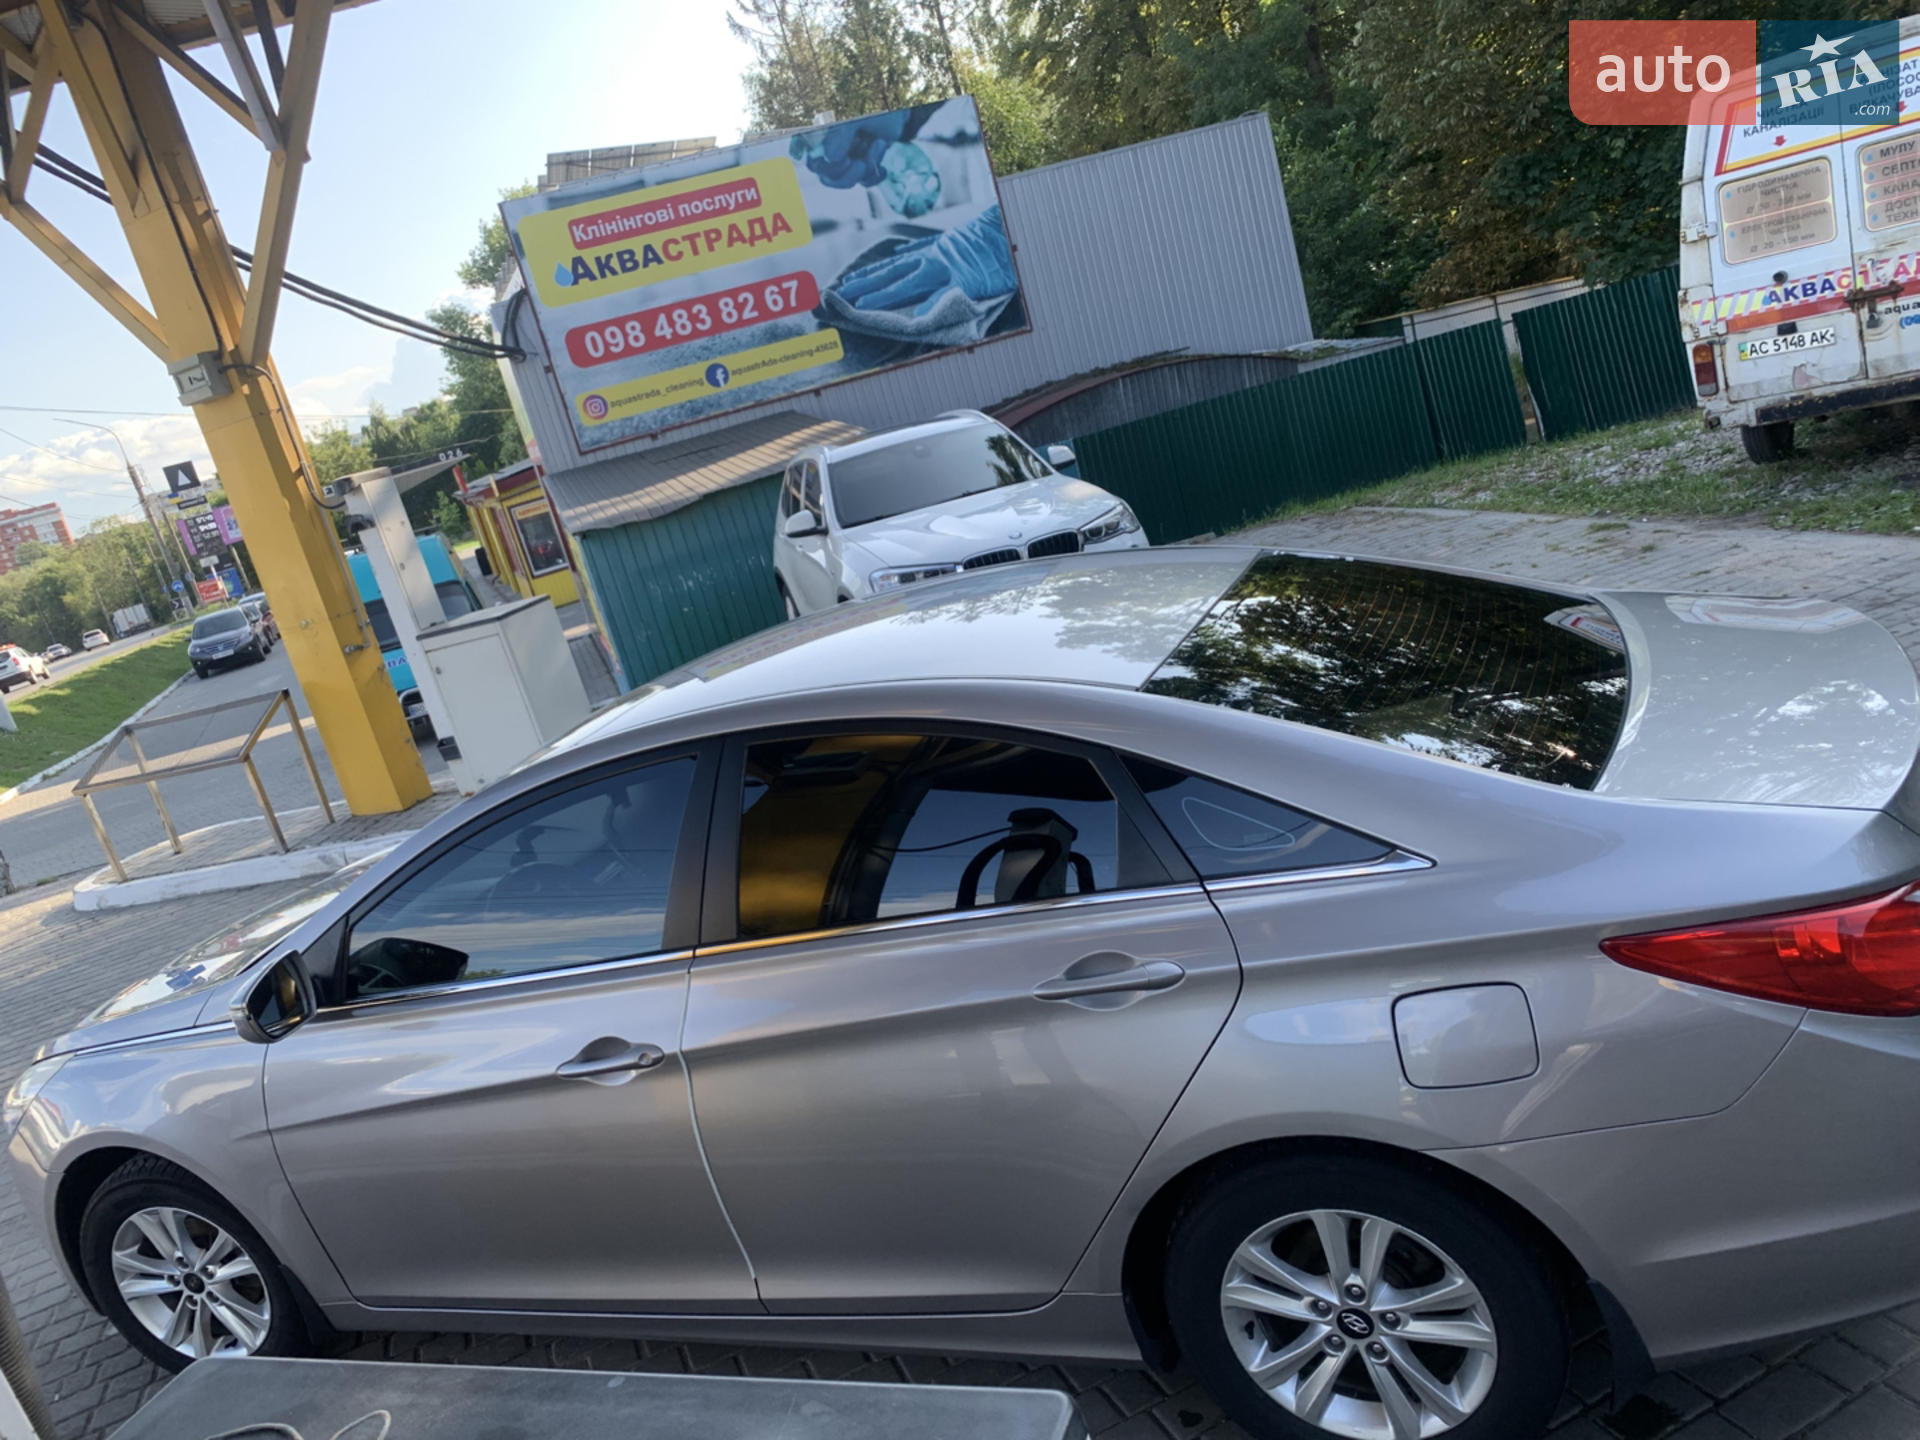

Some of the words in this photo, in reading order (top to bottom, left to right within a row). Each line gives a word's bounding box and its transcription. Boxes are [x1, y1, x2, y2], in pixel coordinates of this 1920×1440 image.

[1743, 105, 1824, 137] КАНАЛІЗАЦІЇ
[1880, 140, 1915, 158] МУЛУ
[1736, 165, 1821, 194] ГІДРОДИНАМІЧНА
[1761, 181, 1799, 197] ЧИСТКА
[571, 202, 675, 243] Клінінгові
[679, 187, 758, 217] послуги
[1768, 223, 1802, 236] ЧИСТКА
[570, 212, 793, 286] АКВАСТРАДА
[1763, 240, 1774, 250] 20
[584, 320, 646, 358] 098
[654, 303, 712, 340] 483
[718, 292, 759, 324] 82
[764, 279, 799, 312] 67
[1749, 341, 1769, 357] AC
[1773, 334, 1806, 352] 5148
[1809, 329, 1832, 346] AK
